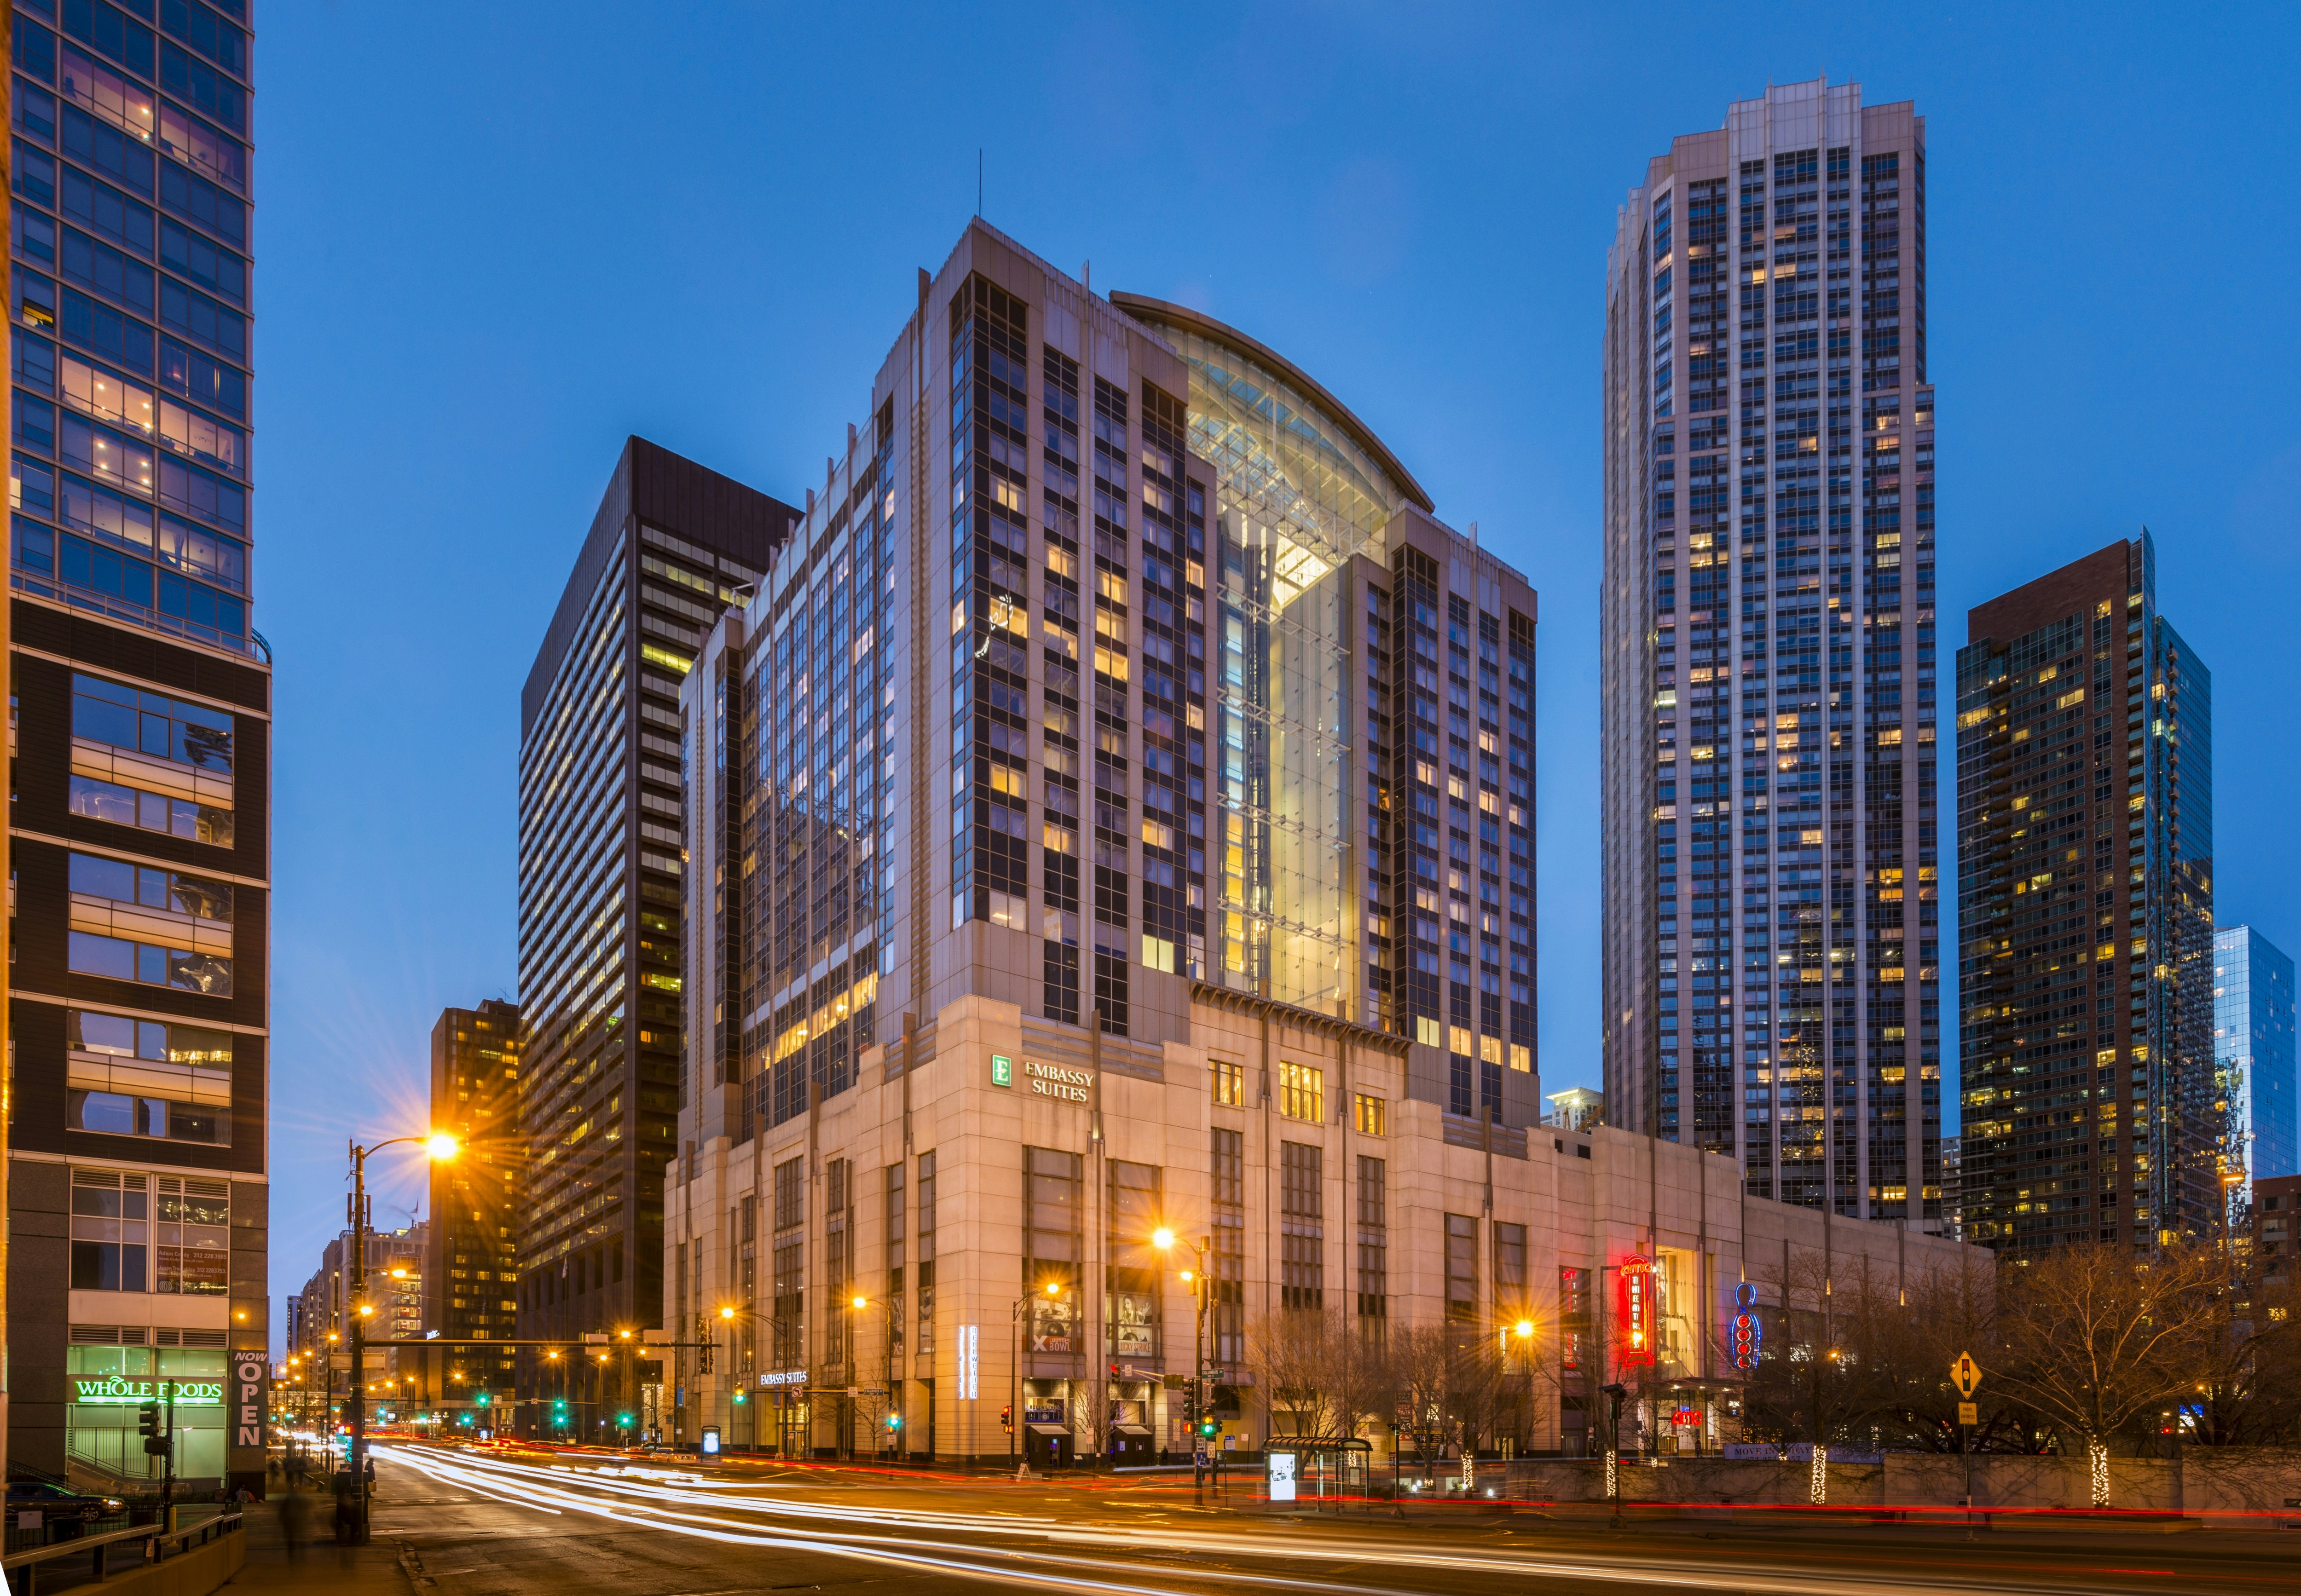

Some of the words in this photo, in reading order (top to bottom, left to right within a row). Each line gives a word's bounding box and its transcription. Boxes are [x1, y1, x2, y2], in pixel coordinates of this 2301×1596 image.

[1025, 1061, 1094, 1087] EMBASSY
[1032, 1079, 1087, 1102] SUITES
[1050, 1342, 1071, 1352] BOWL
[1119, 1341, 1133, 1351] UCKY
[1134, 1342, 1150, 1353] STRIKE
[1738, 1316, 1749, 1368] BOWL
[235, 1352, 267, 1361] NOW
[761, 1373, 786, 1385] EMBASSY
[786, 1371, 807, 1383] SUITES
[75, 1379, 152, 1396] WHOLE
[157, 1383, 222, 1397] FOODS
[238, 1362, 262, 1446] OPEN
[1672, 1410, 1702, 1426] amc
